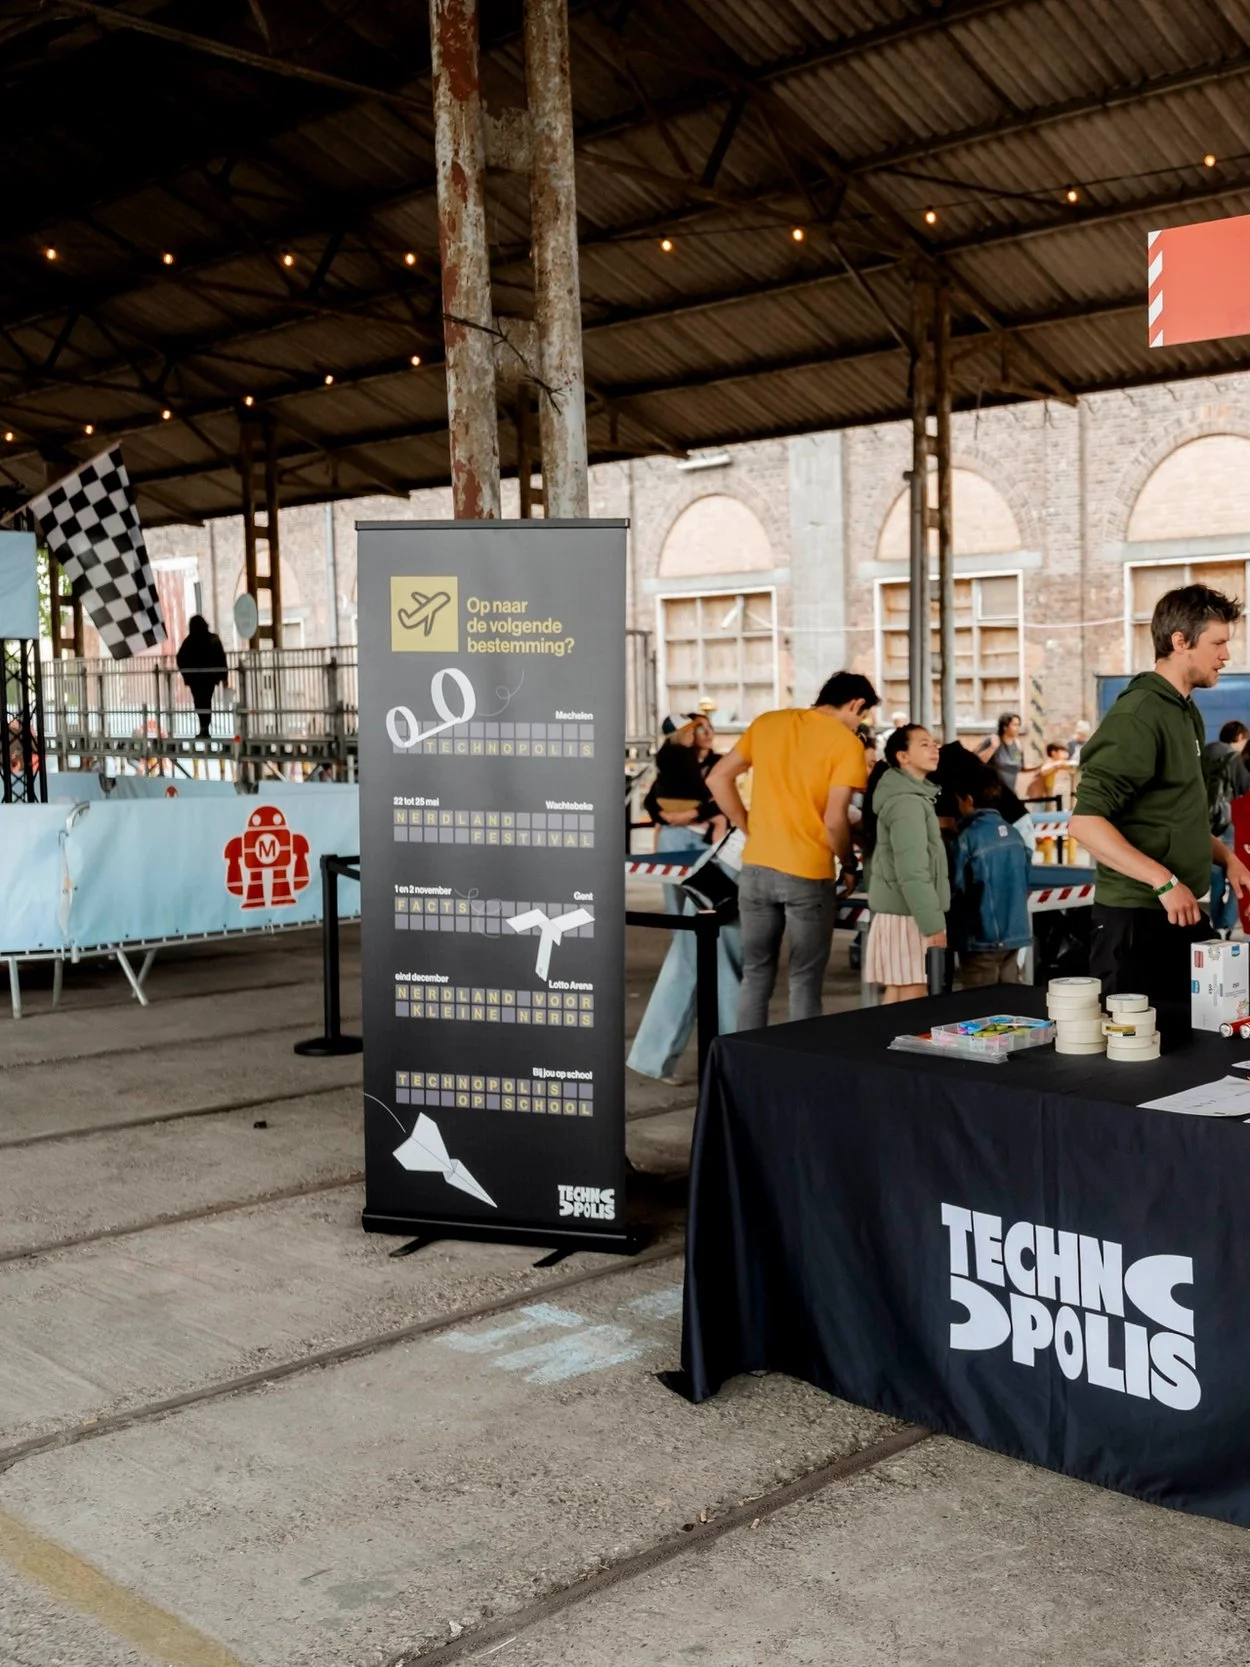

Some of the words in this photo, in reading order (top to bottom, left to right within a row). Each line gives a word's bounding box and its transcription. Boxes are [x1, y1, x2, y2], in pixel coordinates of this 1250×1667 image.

[467, 597, 490, 616] Op
[493, 600, 528, 613] naar
[467, 618, 486, 633] de
[489, 618, 562, 636] volgende
[467, 637, 575, 657] bestemming?
[555, 710, 594, 721] Mechelen
[427, 742, 591, 756] TECHNOPOLIS
[404, 797, 414, 806] tot
[425, 798, 440, 806] mei
[545, 800, 594, 811] Wachtebeke
[396, 812, 513, 826] NERDLAND
[474, 831, 592, 846] FESTIVAL
[258, 840, 276, 858] M
[415, 886, 452, 896] november
[573, 892, 594, 901] Gent
[397, 901, 468, 913] FACTS
[395, 973, 411, 982] eind
[411, 974, 449, 983] december
[549, 980, 569, 990] Lotto
[569, 982, 593, 991] Arena
[399, 987, 513, 1004] NERDLAND
[536, 994, 590, 1009] VOOR
[413, 1006, 498, 1020] KLEINE
[520, 1011, 590, 1025] NERDS
[543, 1068, 555, 1078] jou
[556, 1071, 566, 1079] op
[567, 1070, 593, 1080] school
[399, 1074, 559, 1096] TECHNOPOLIS
[458, 1095, 482, 1106] OP
[504, 1098, 590, 1114] SCHOOL
